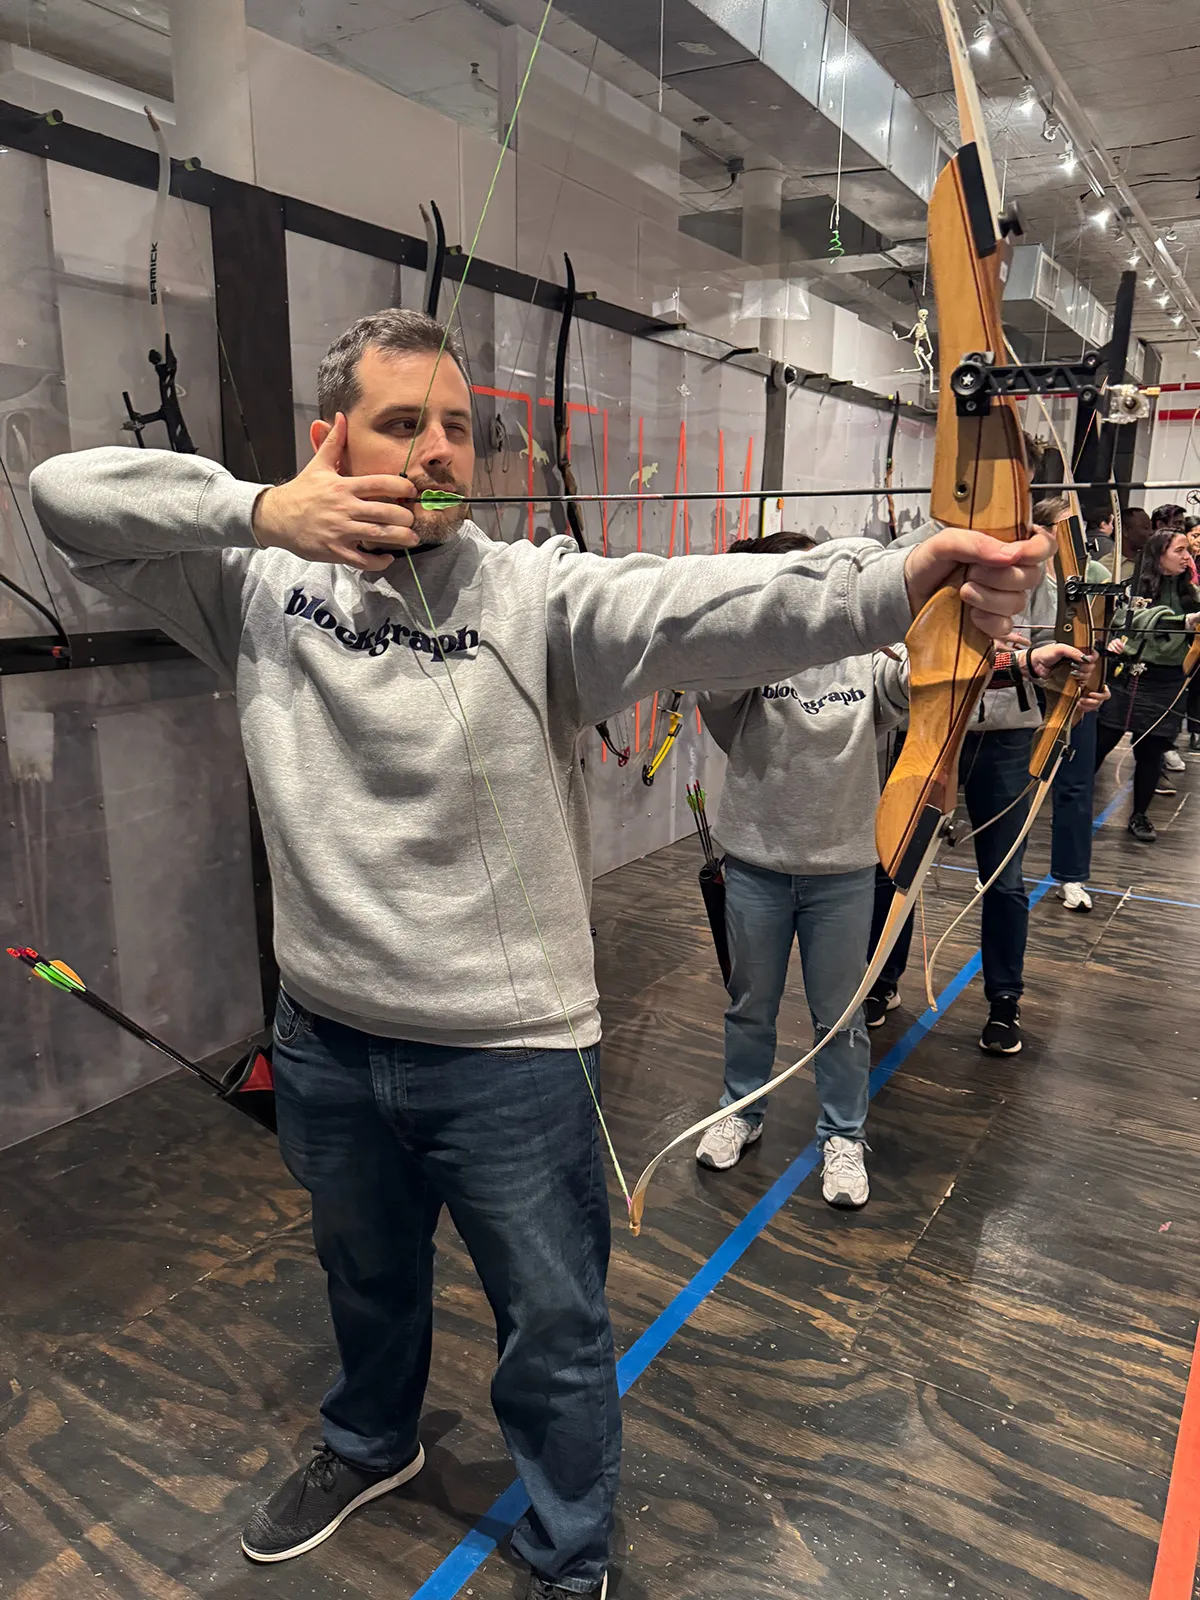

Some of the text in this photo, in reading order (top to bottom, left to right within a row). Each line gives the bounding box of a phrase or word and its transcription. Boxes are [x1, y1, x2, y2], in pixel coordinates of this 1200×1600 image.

[150, 241, 158, 305] SAMICK
[285, 588, 479, 662] blockgraph
[762, 683, 866, 714] blocgraph
